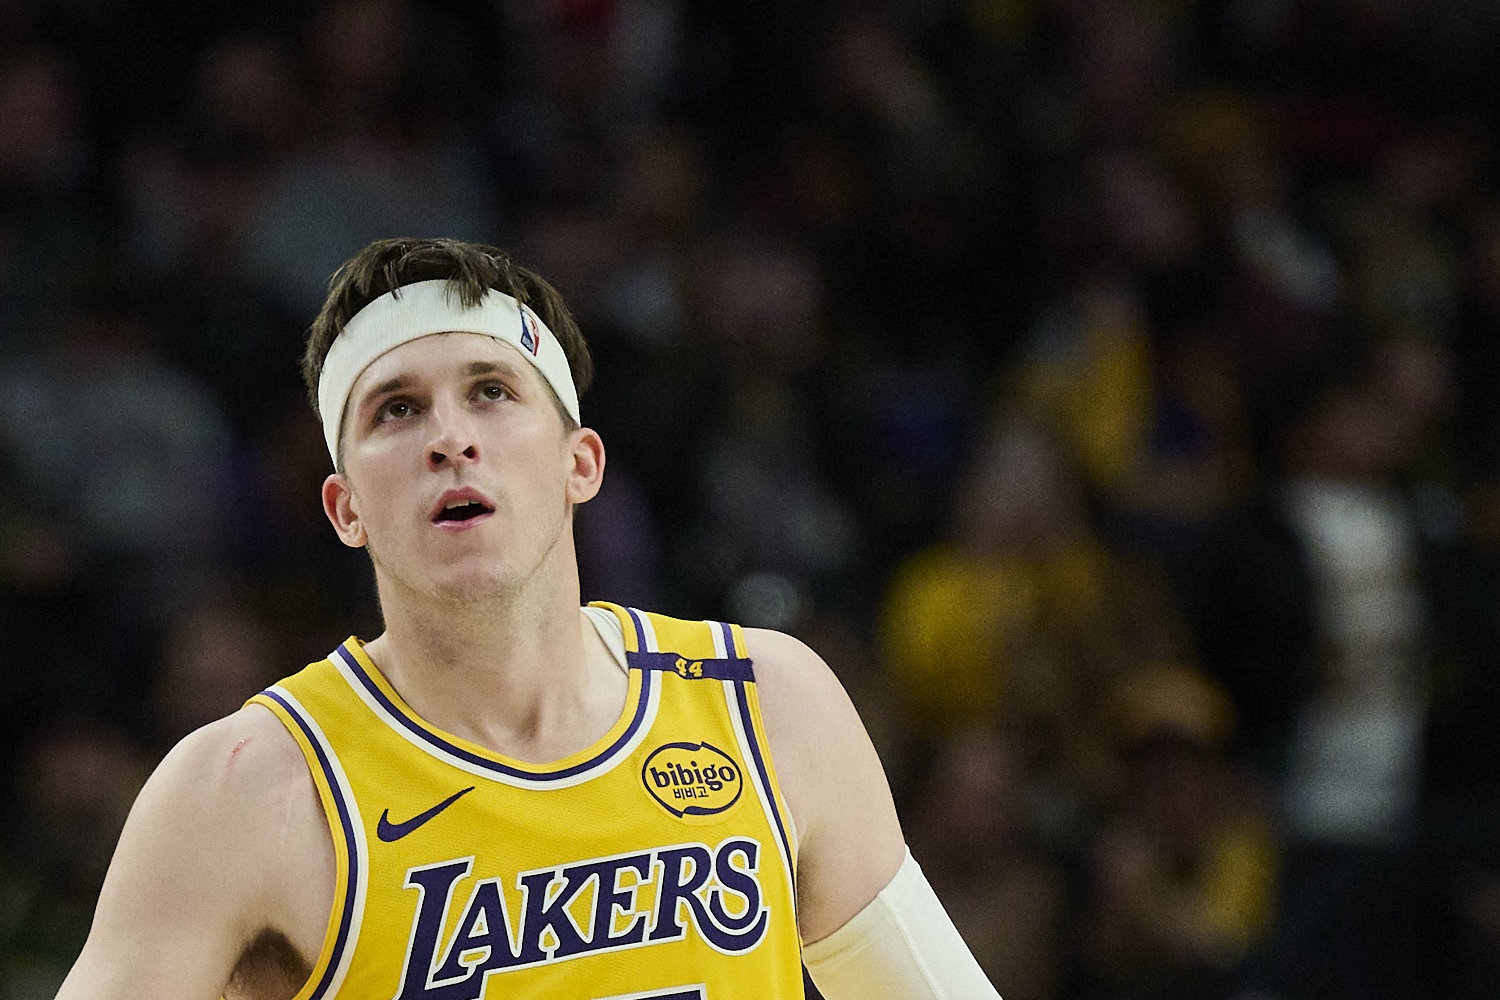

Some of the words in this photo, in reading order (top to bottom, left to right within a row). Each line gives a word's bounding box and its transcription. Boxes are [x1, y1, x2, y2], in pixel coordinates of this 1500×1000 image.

[675, 658, 703, 677] 44
[650, 761, 735, 790] bibigo
[674, 786, 709, 799] 비비고
